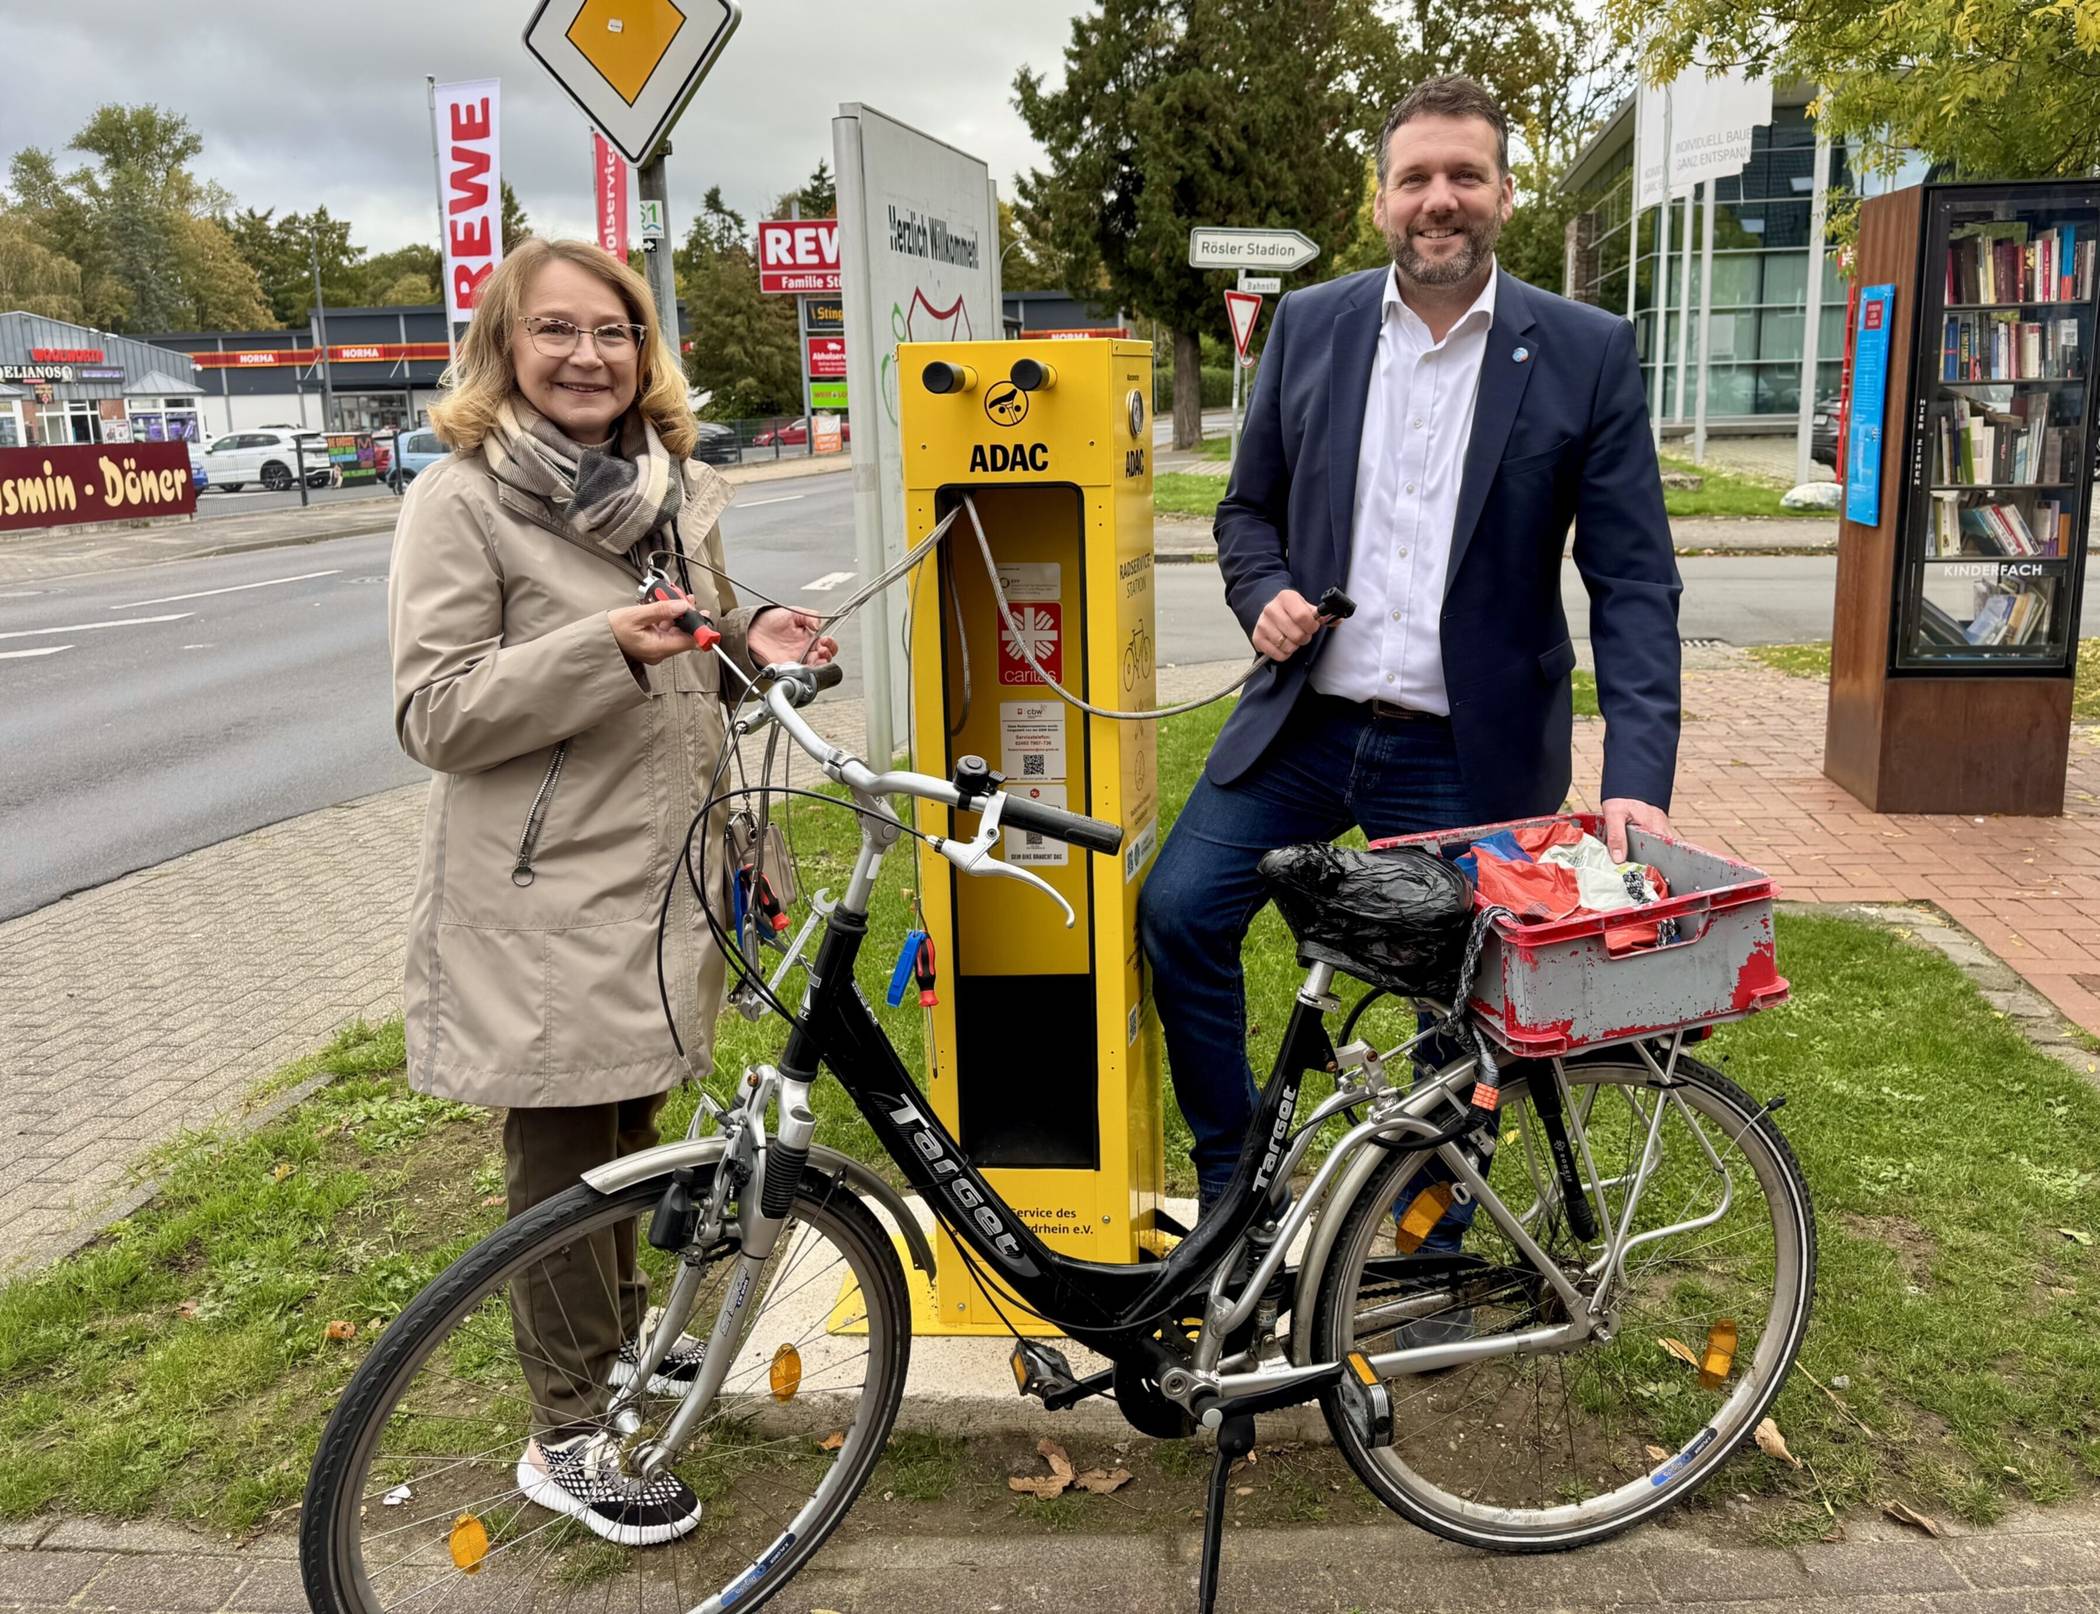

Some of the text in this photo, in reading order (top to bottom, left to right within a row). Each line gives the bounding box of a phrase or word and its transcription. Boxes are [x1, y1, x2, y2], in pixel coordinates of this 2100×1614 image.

[449, 97, 494, 310] REWE
[888, 204, 979, 270] Herzlich Willkommen!
[1201, 241, 1296, 256] Rösler Stadion
[781, 275, 824, 289] Familie
[239, 353, 275, 363] NORMA
[342, 348, 379, 358] NORMA
[1913, 398, 1927, 486] HIER ZIEHEN
[969, 443, 1049, 473] ADAC
[1125, 449, 1145, 478] ADAC
[0, 456, 188, 516] smin Döner
[1944, 564, 2043, 577] KINDERFACH
[1126, 575, 1148, 599] STATION
[1056, 1208, 1077, 1218] des
[1072, 1225, 1094, 1235] e.V.
